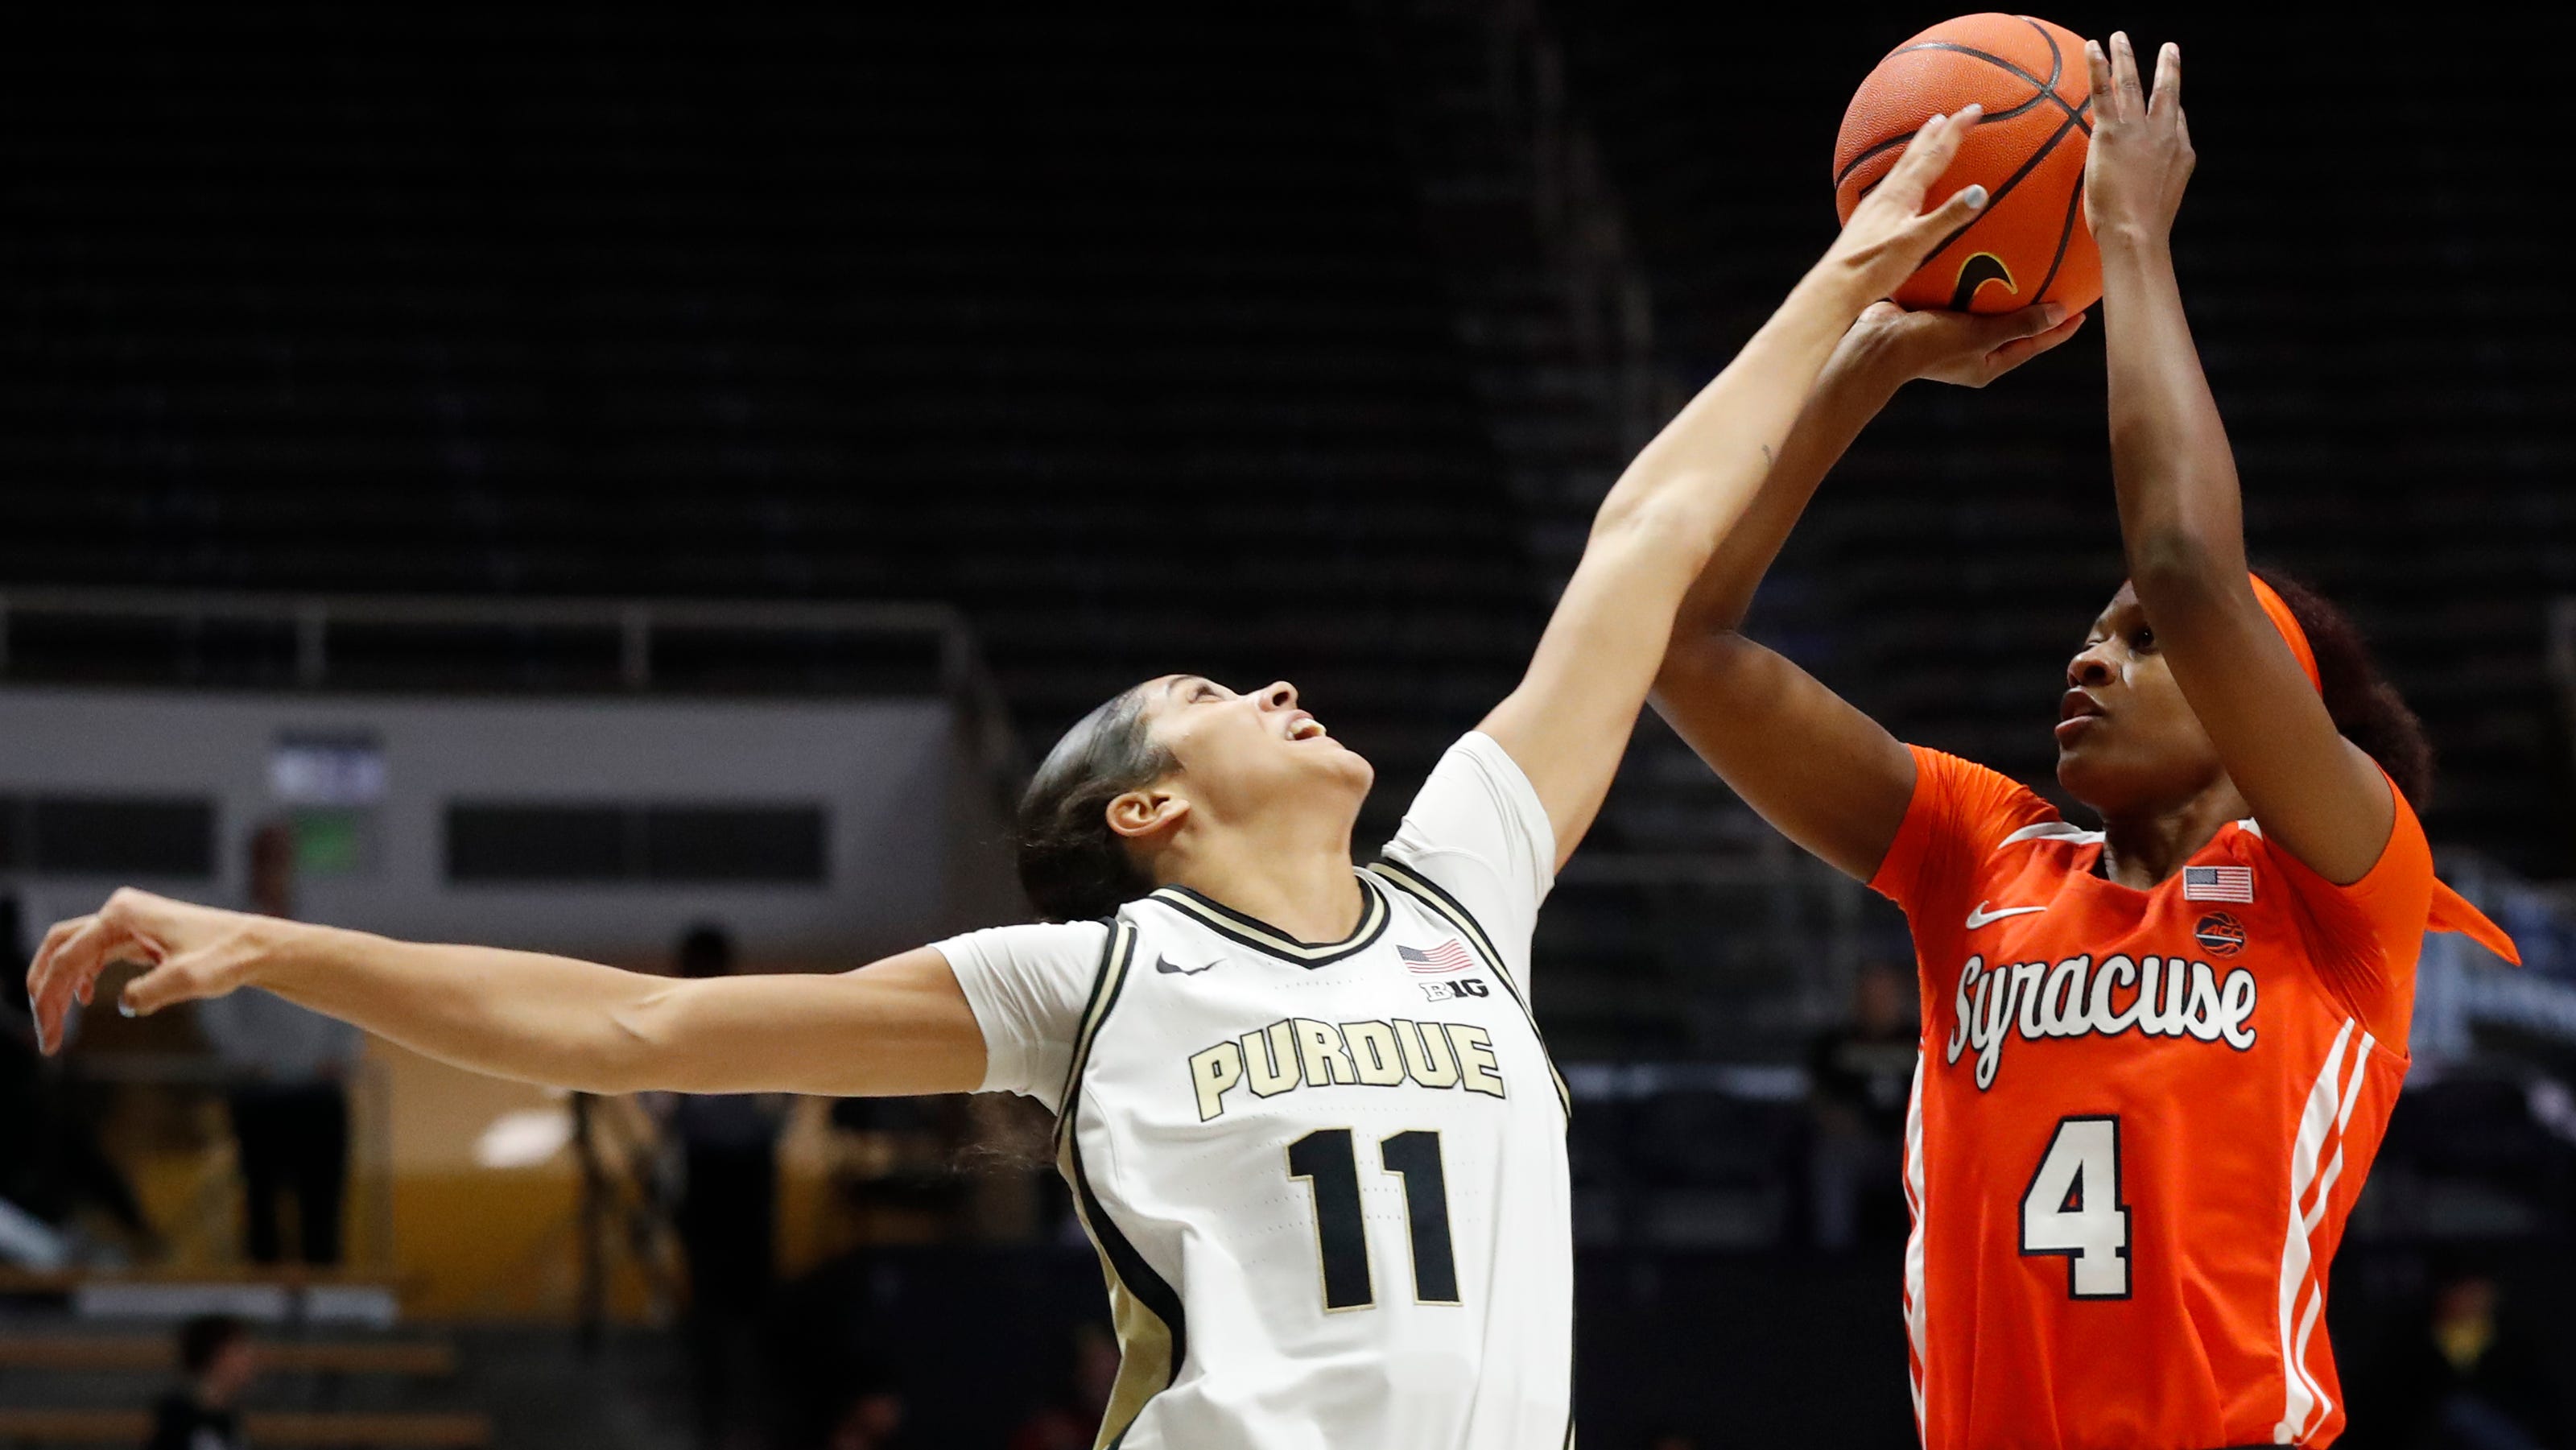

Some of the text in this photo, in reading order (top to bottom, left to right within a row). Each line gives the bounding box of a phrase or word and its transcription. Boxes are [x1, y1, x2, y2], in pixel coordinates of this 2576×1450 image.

[1189, 1018, 1506, 1122] PURDUE
[1946, 953, 2256, 1092] Syracuse
[1286, 1126, 1463, 1314] 11
[2018, 1114, 2132, 1299] 4
